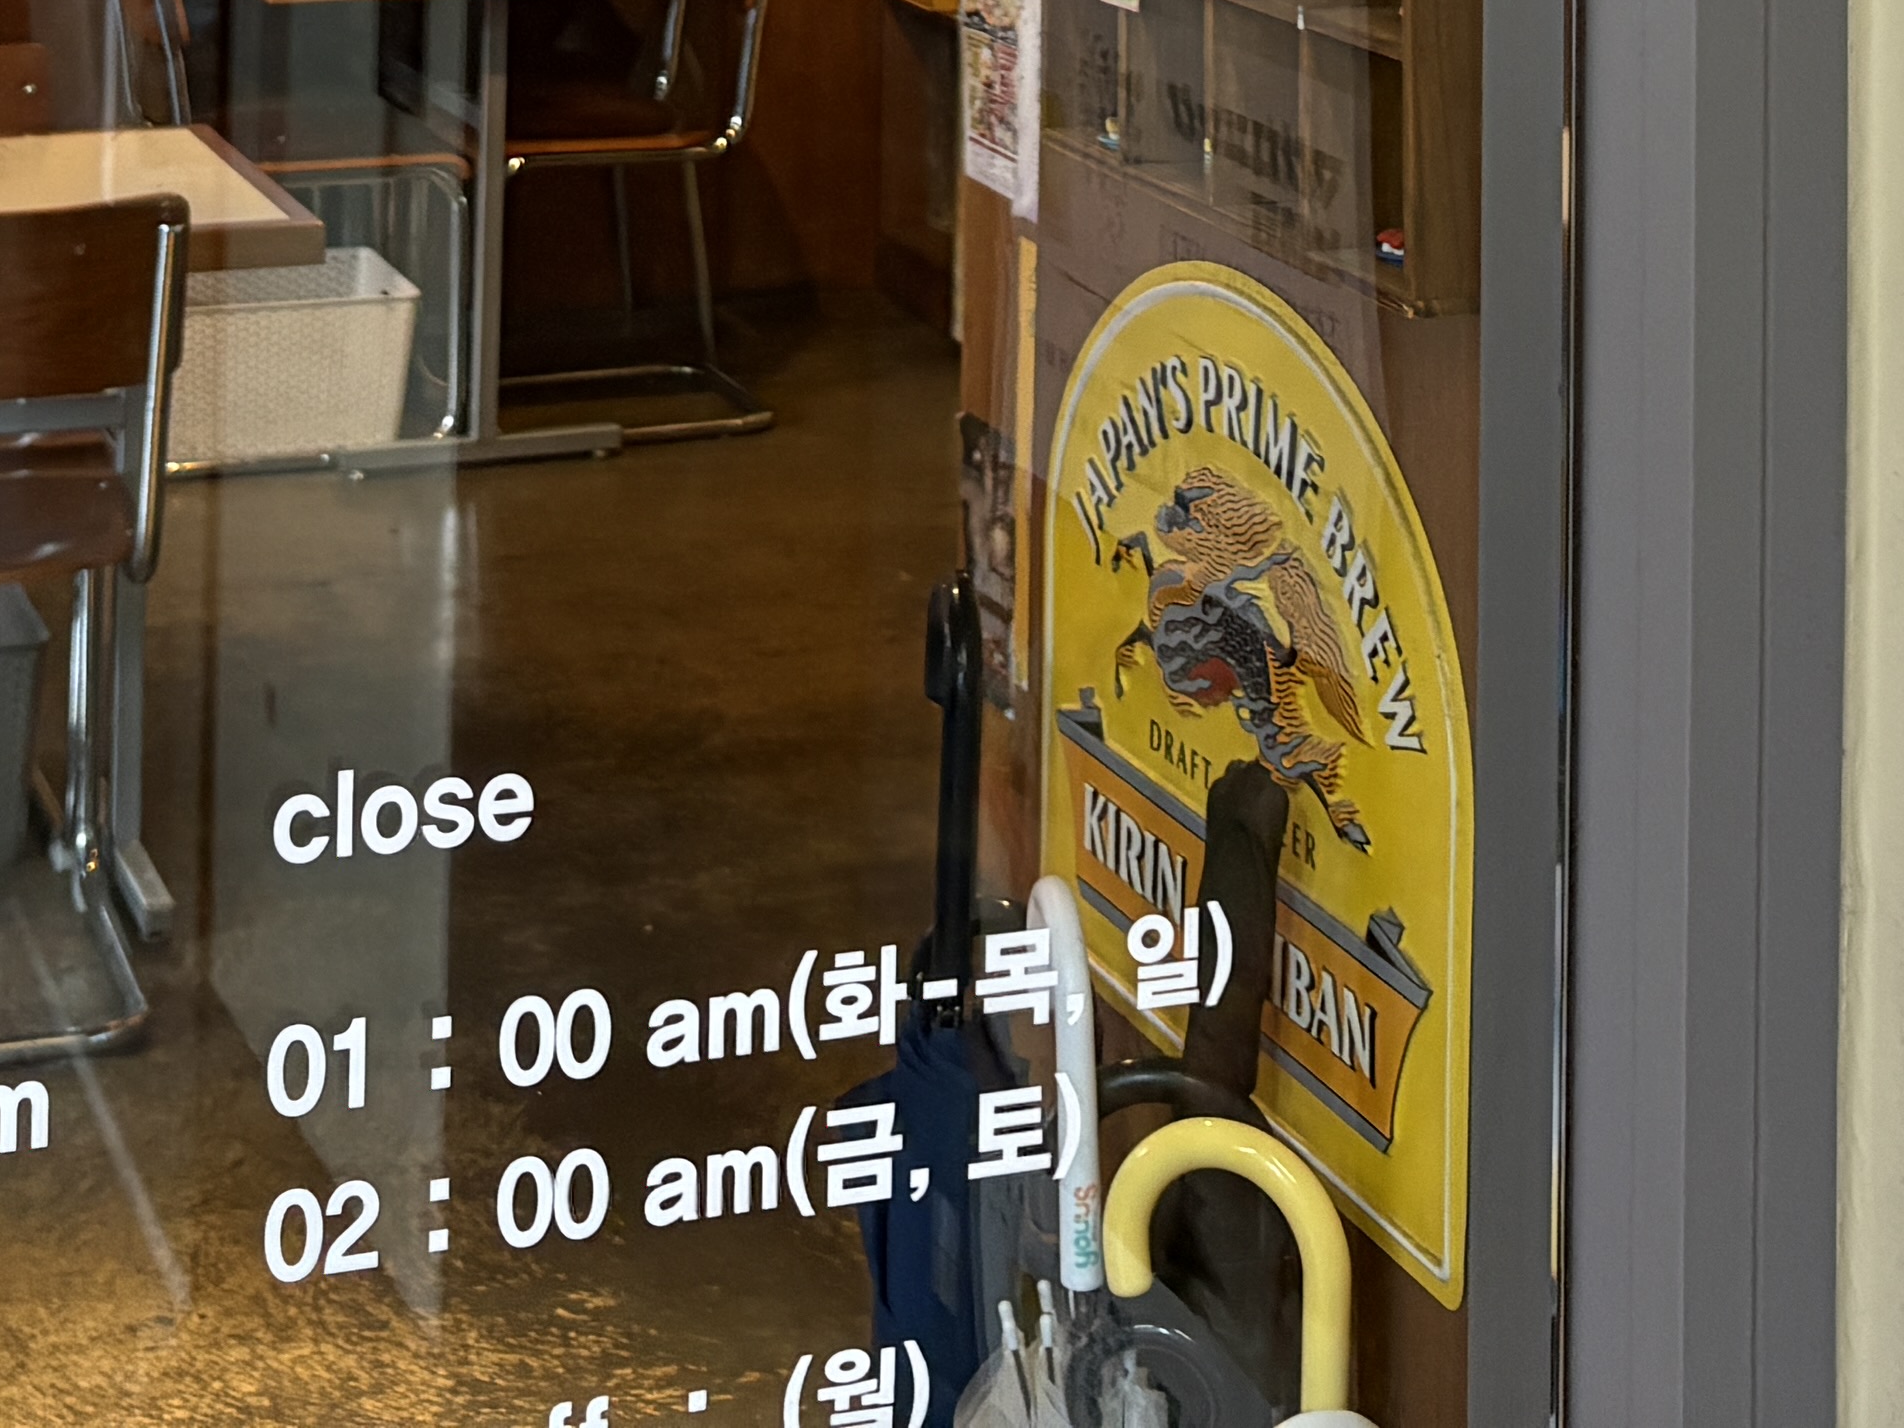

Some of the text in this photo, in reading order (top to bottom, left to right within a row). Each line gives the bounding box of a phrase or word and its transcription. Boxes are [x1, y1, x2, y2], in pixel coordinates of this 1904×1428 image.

[1196, 354, 1326, 526] PRIME
[1320, 488, 1429, 756] BREW
[271, 768, 536, 865] close
[1148, 718, 1214, 791] DRAFT
[1082, 782, 1188, 929] KIRIN
[265, 1017, 368, 1118] 01
[497, 988, 614, 1088] 00
[263, 1178, 382, 1284] 02
[495, 1147, 611, 1249] 00
[967, 1071, 1083, 1181] 토)
